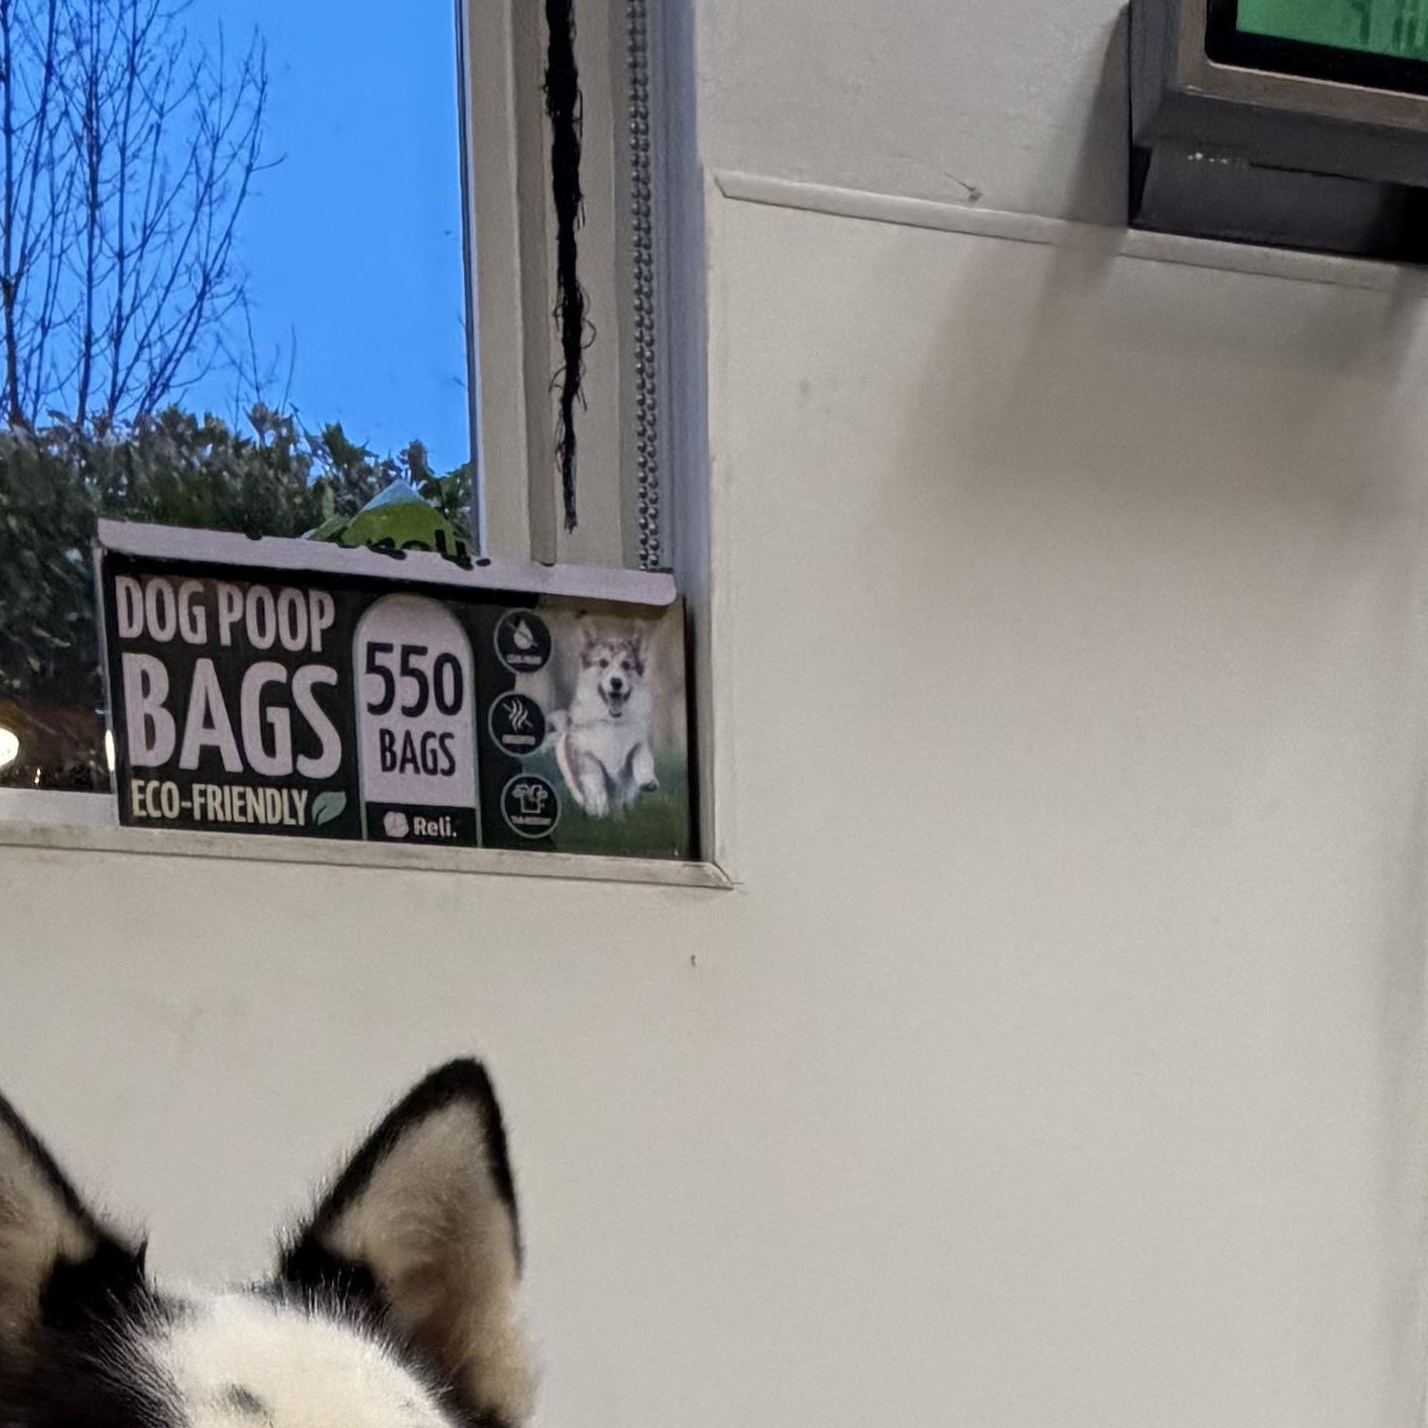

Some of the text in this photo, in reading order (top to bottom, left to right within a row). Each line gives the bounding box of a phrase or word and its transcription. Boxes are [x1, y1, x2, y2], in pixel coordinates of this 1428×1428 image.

[115, 575, 335, 653] DOG POOP
[121, 652, 343, 779] BAGS
[365, 641, 464, 718] 550
[379, 728, 456, 777] BAGS
[130, 779, 309, 826] ECO-FRIENDLY
